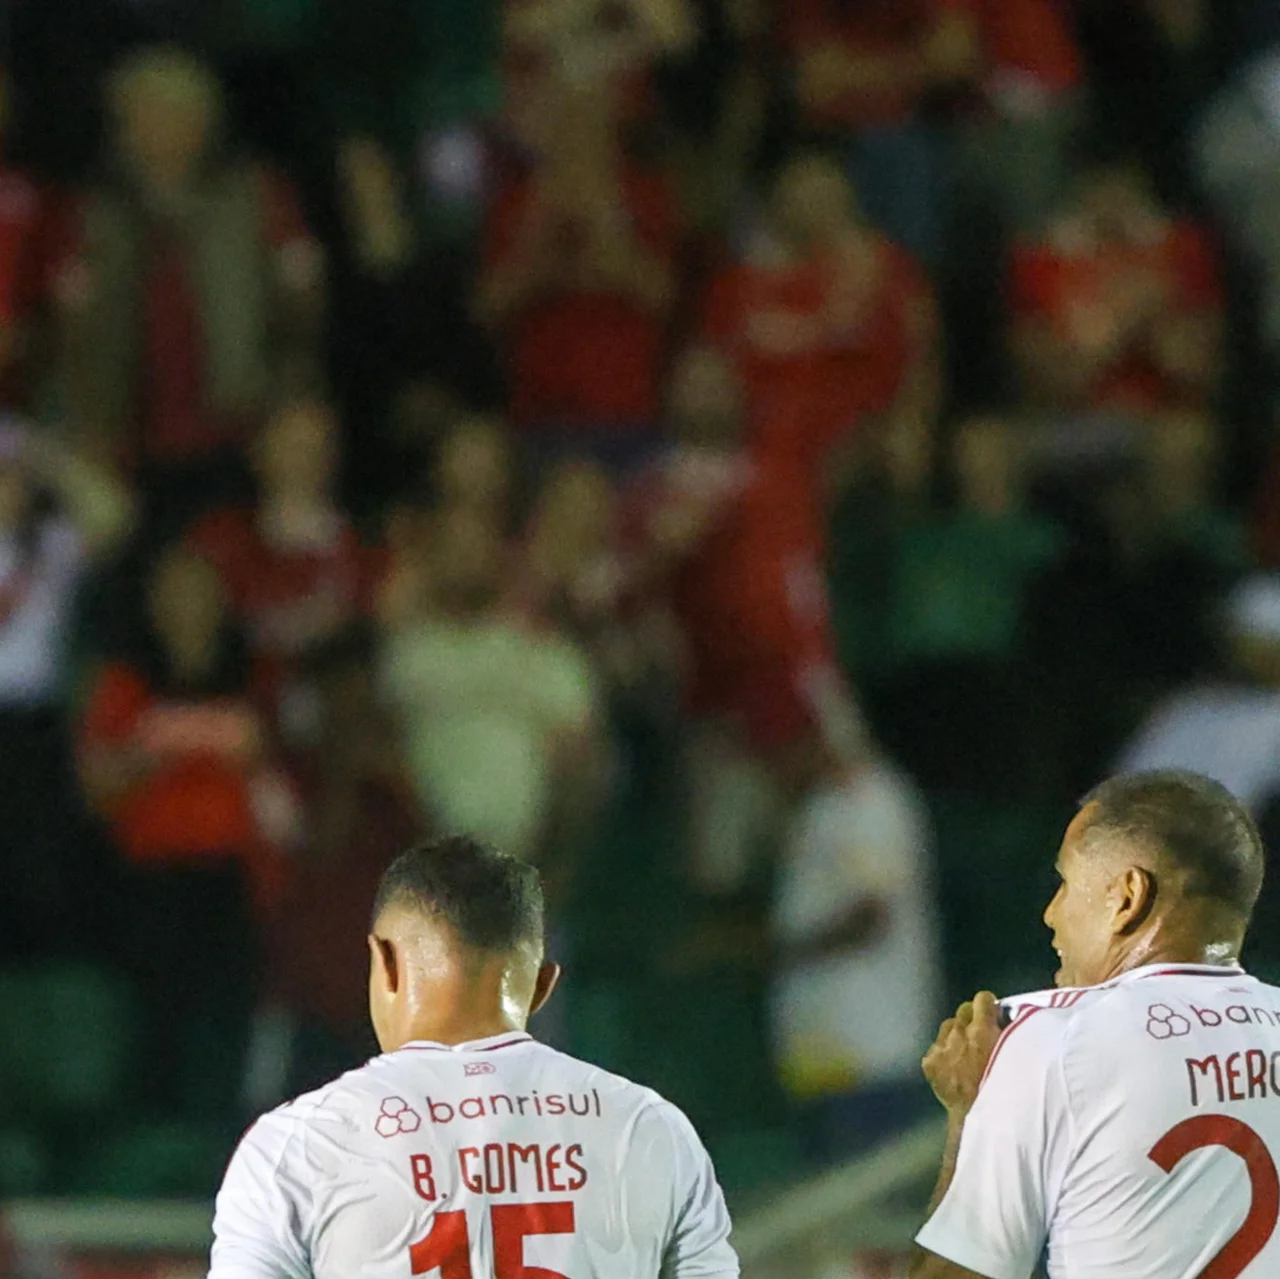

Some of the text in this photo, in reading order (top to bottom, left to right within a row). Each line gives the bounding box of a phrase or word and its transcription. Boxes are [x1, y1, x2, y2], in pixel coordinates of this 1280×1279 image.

[426, 1088, 602, 1124] banrisul
[409, 1141, 588, 1202] B. GOMES
